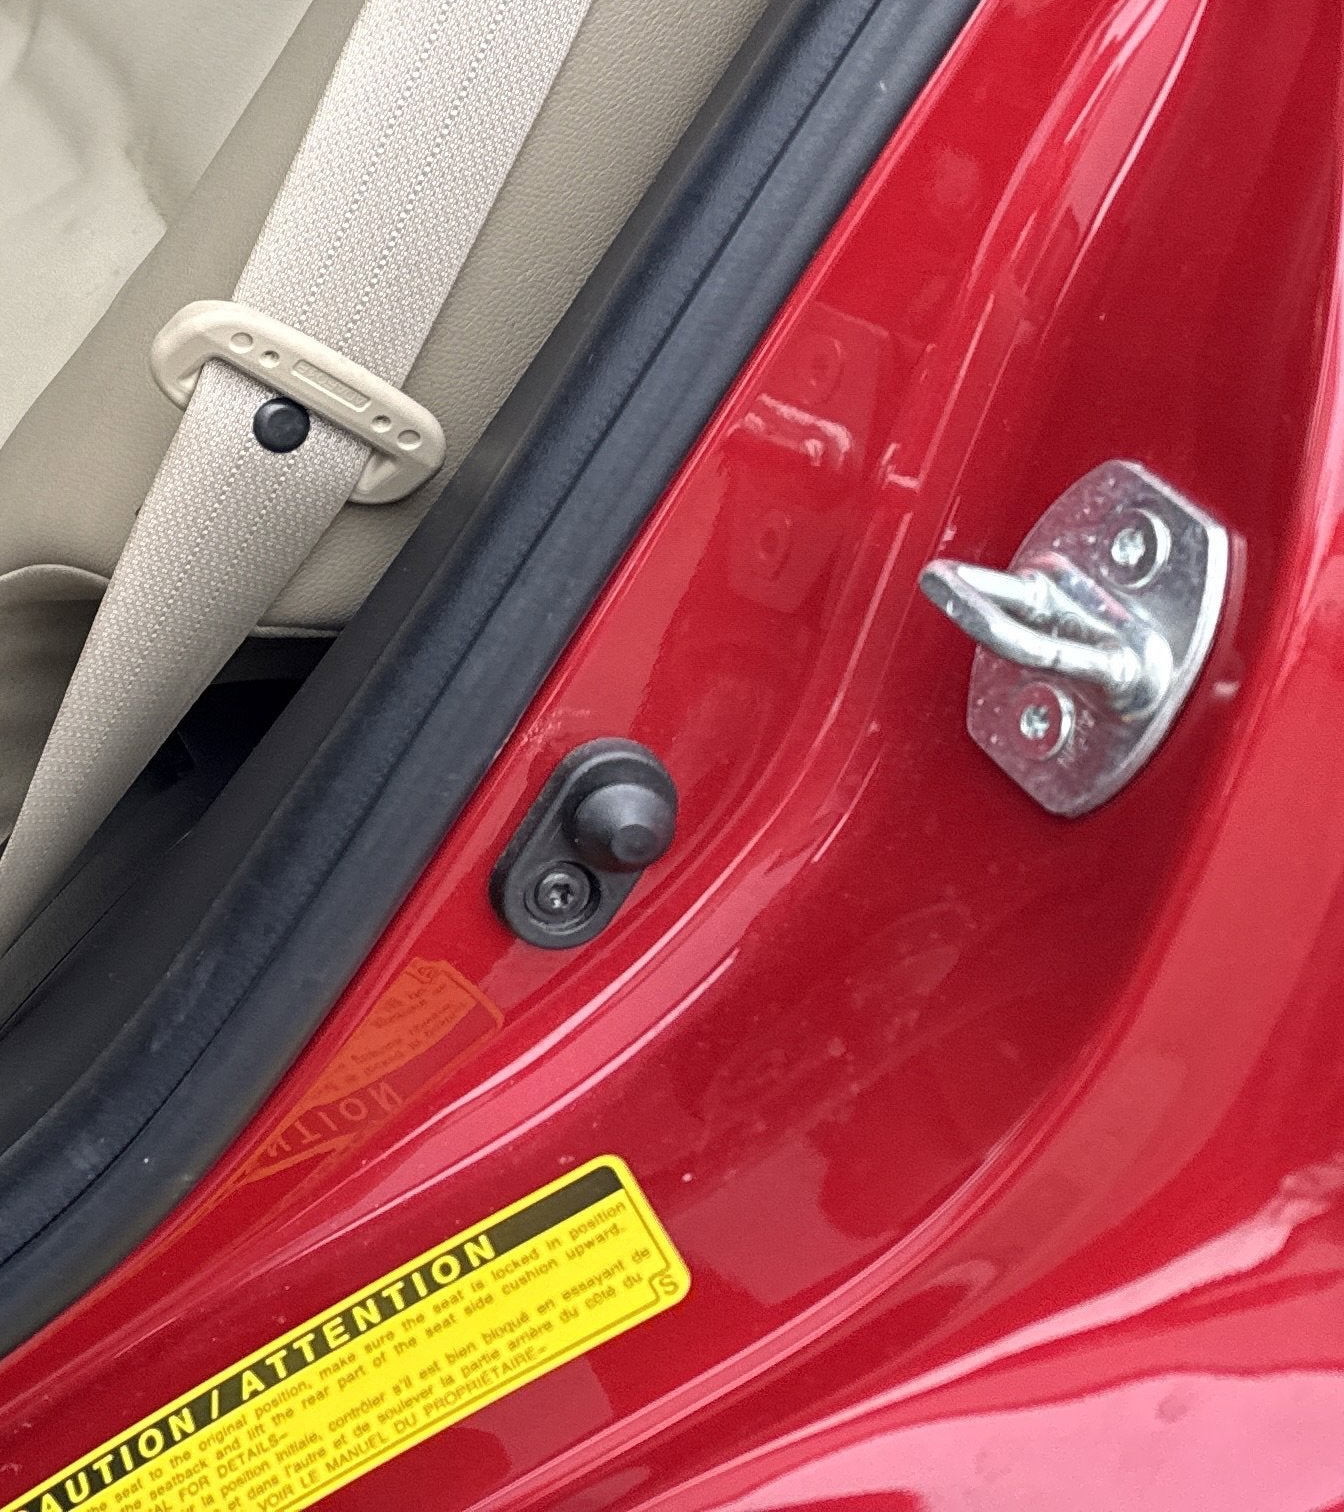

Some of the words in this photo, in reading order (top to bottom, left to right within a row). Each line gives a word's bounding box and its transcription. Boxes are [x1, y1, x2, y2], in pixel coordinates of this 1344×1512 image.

[658, 1272, 680, 1296] S
[11, 1406, 195, 1512] AUTION
[242, 1233, 496, 1400] ATTENTION
